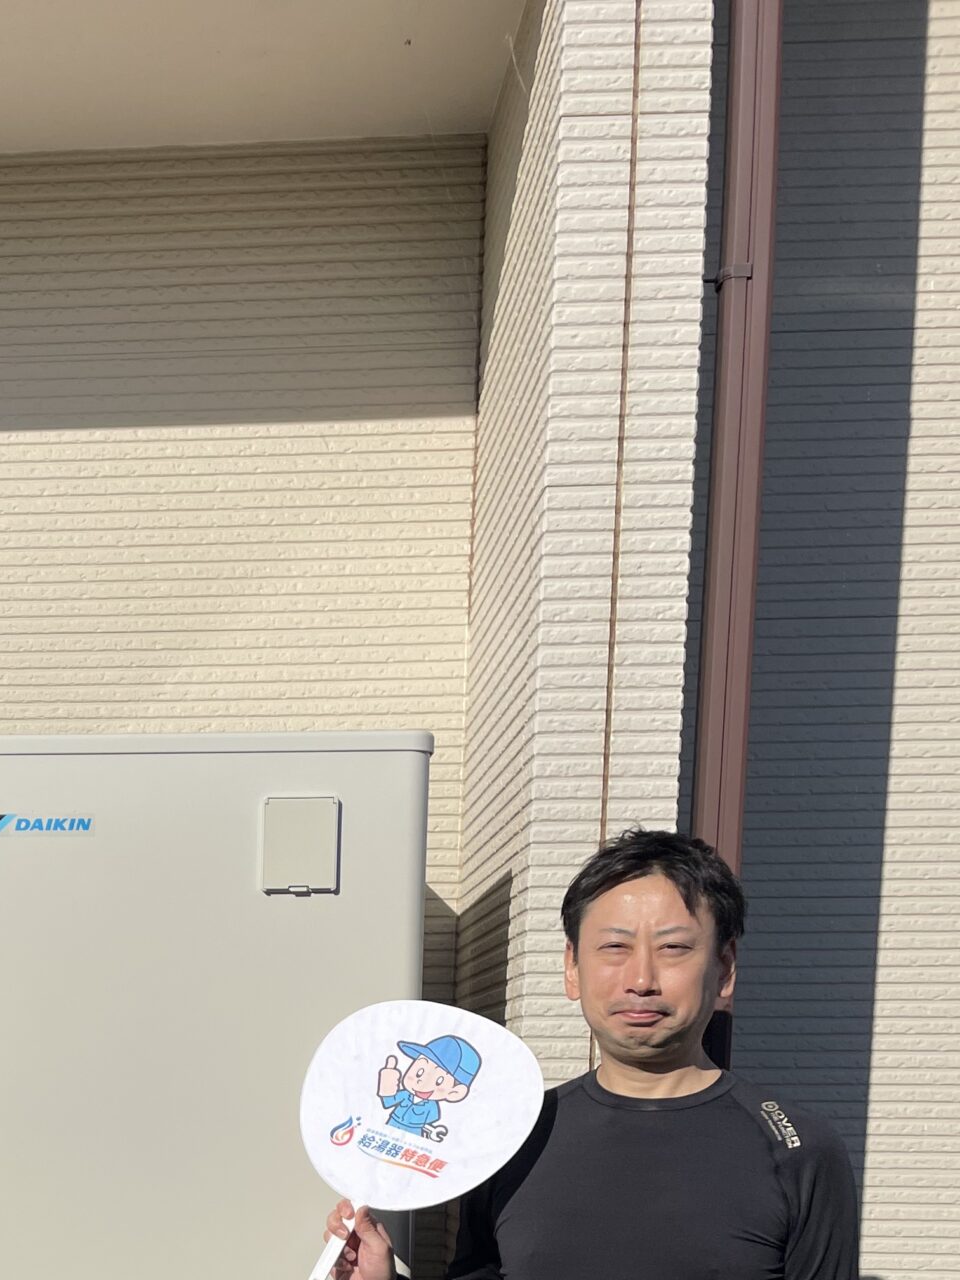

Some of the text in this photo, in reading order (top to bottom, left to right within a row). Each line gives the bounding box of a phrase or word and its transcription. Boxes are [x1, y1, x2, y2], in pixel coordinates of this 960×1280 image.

[15, 818, 92, 831] DAIKIN
[358, 1134, 448, 1173] 給湯器特急便
